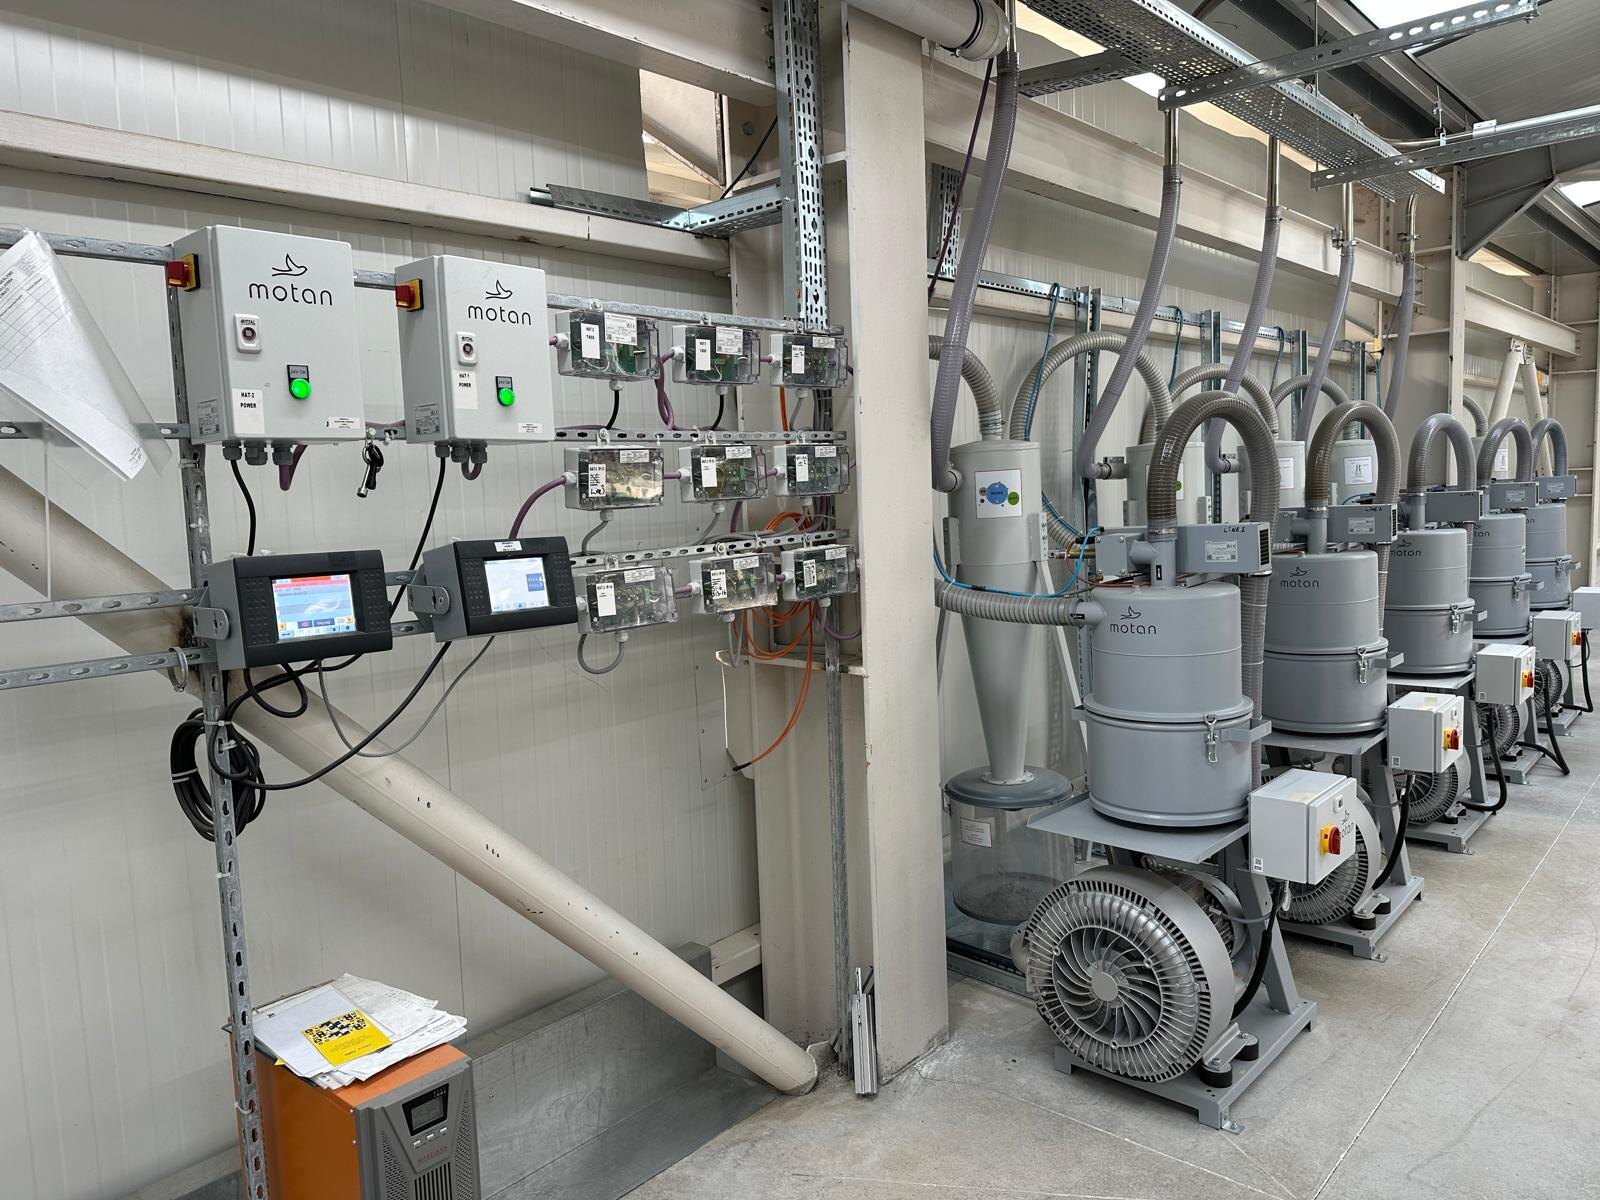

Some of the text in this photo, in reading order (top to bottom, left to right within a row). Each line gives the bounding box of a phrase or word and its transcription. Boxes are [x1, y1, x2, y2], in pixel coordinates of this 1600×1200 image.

[249, 283, 332, 306] motan
[468, 305, 531, 326] motan
[1280, 578, 1320, 589] motan
[1109, 623, 1157, 635] motan
